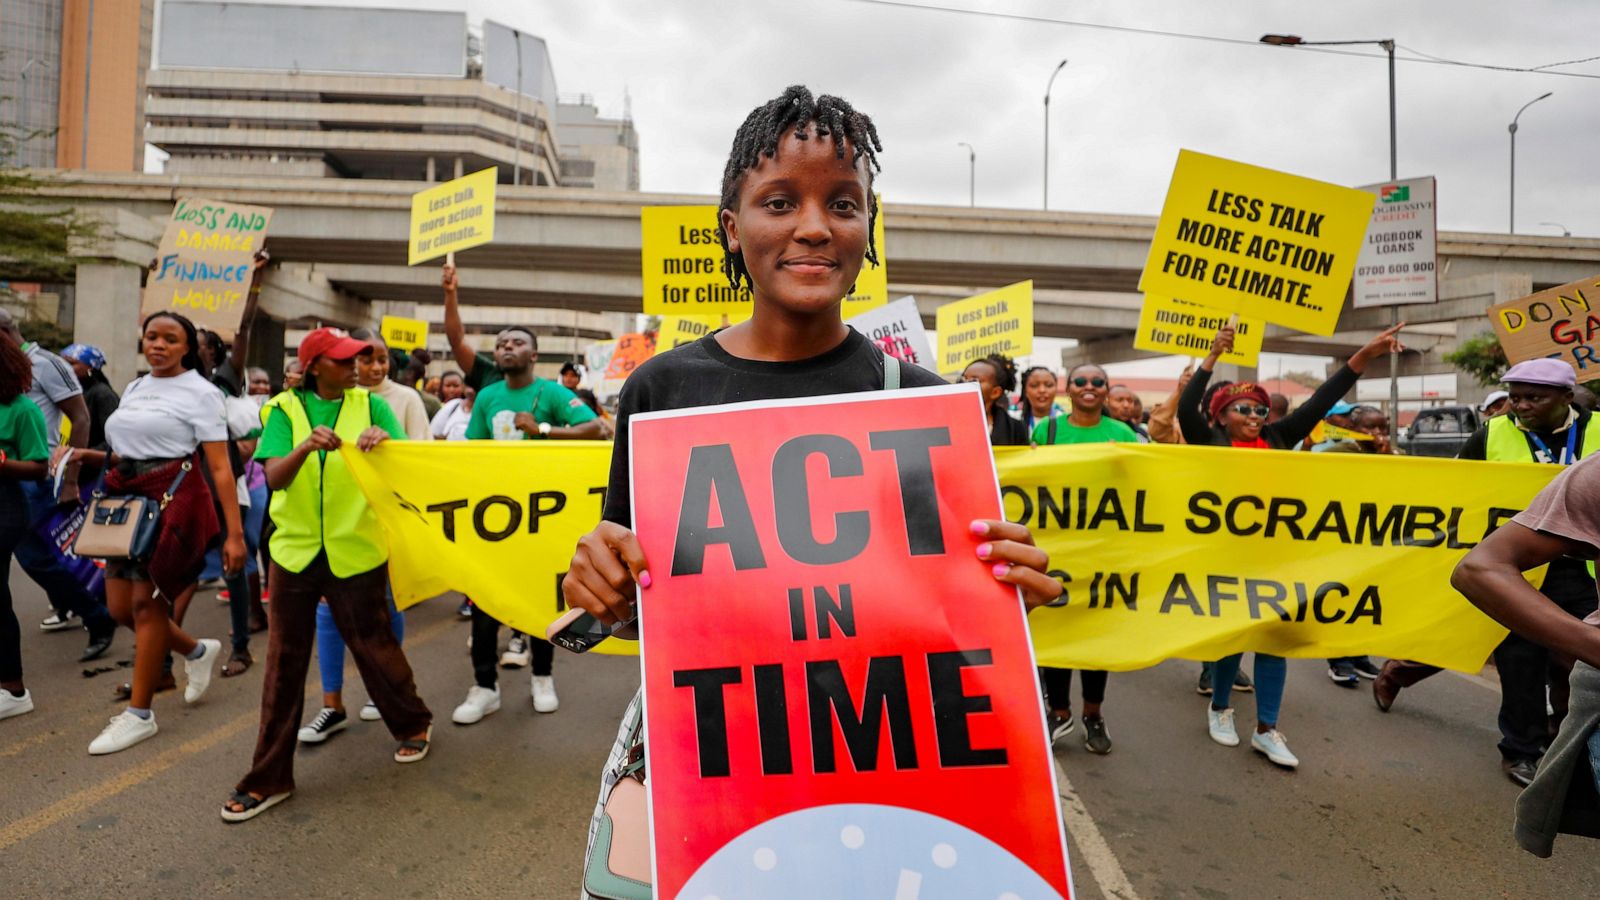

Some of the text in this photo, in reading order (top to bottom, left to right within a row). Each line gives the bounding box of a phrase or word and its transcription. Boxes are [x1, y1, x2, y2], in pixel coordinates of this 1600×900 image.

[428, 187, 474, 212] Less talk
[1372, 201, 1432, 215] OGRESSIVE
[175, 201, 265, 232] LOSS AND
[419, 204, 483, 234] more action
[1207, 188, 1325, 238] LESS TALK
[1374, 211, 1416, 222] CREDIT
[175, 228, 254, 251] DAMAGE
[417, 238, 432, 253] for
[680, 225, 721, 245] Less
[1176, 217, 1335, 276] MORE ACTION
[1369, 229, 1423, 244] LOGBOOK
[1376, 242, 1415, 255] LOANS
[156, 253, 248, 282] FINANCE
[663, 257, 714, 274] more
[1358, 265, 1385, 277] 0700
[1413, 261, 1434, 272] 900
[662, 283, 750, 303] for clima
[1162, 250, 1323, 311] FOR CLIMATE...
[956, 300, 1008, 326] Less talk
[1156, 309, 1248, 335] more actin
[678, 319, 709, 336] mor
[947, 318, 1019, 346] more action
[1151, 328, 1173, 344] for
[946, 351, 962, 365] for
[671, 426, 952, 577] ACT
[1000, 485, 1164, 532] ONIAL
[426, 490, 567, 543] TOP
[1088, 572, 1140, 611] IN
[1159, 572, 1384, 625] AFRICA
[787, 583, 857, 642] IN
[672, 648, 1009, 779] TIME
